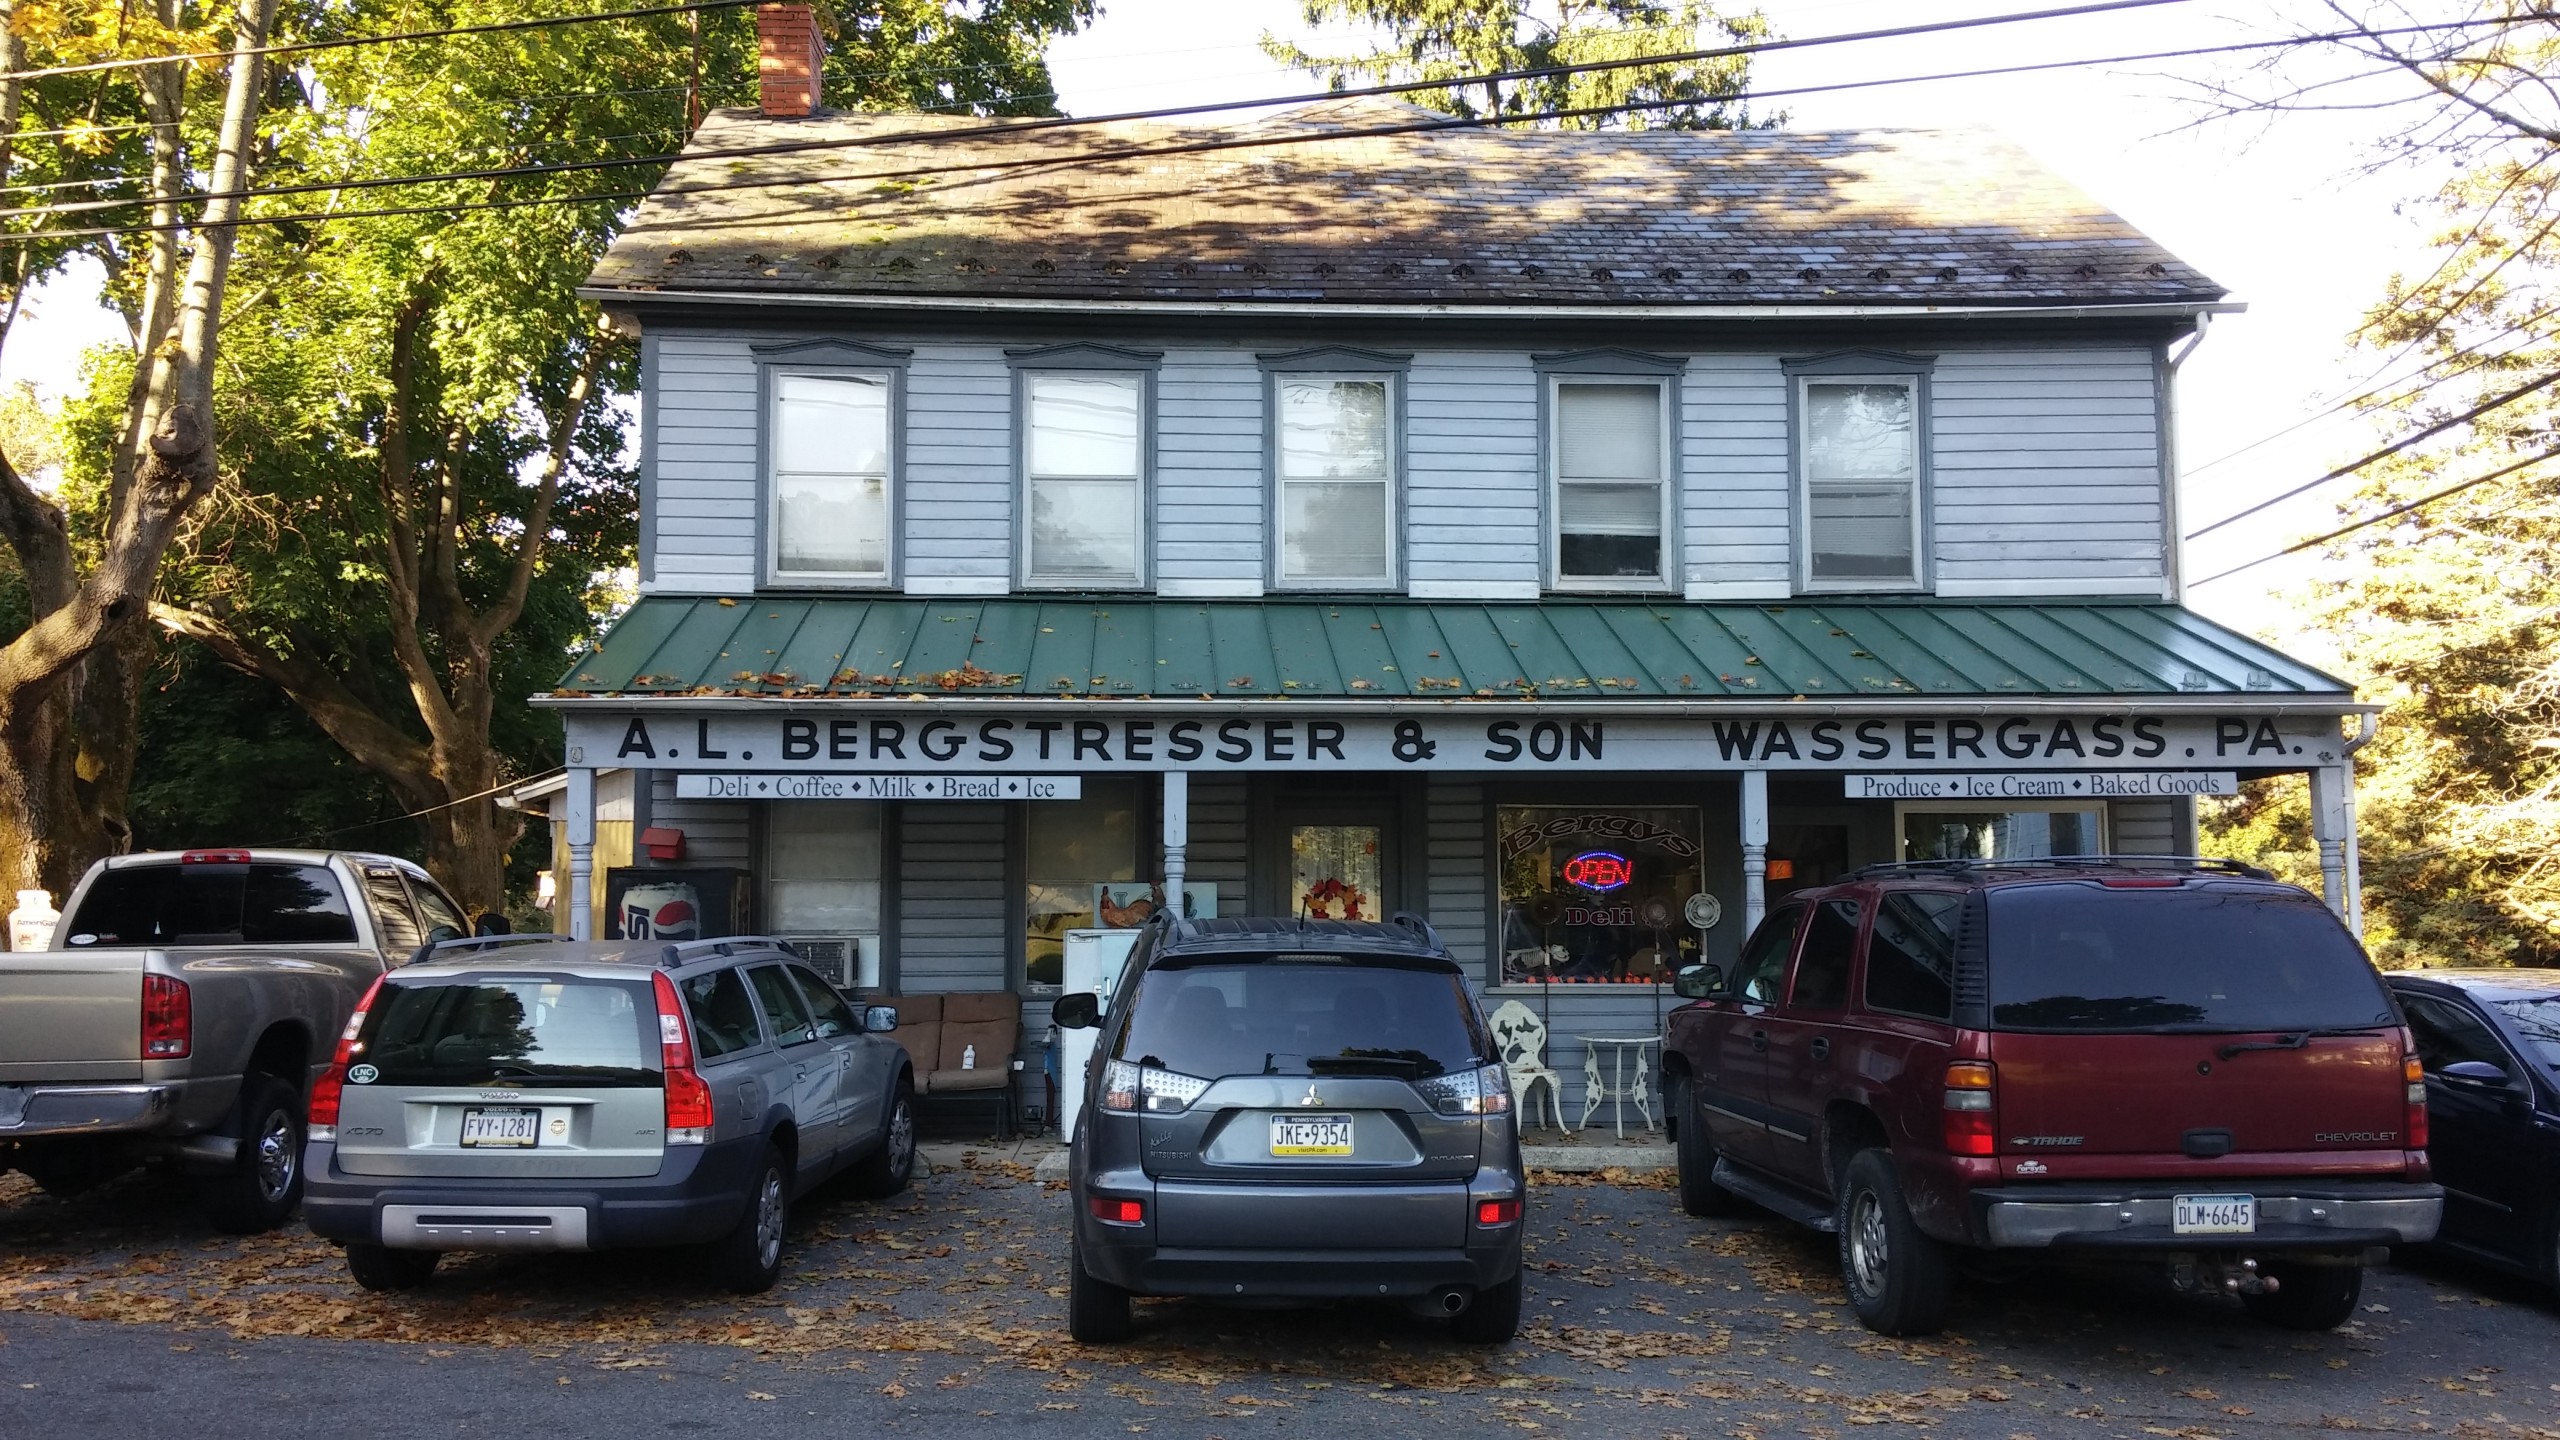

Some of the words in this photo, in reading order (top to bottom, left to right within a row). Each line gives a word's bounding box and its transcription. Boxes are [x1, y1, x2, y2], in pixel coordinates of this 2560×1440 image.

[781, 718, 1346, 762] BERGSTRESSER
[1391, 718, 1436, 761] &
[1484, 719, 1603, 763] SON
[707, 775, 750, 797] Deli
[775, 775, 844, 798] Coffee
[868, 775, 917, 798] Milk
[941, 775, 1000, 798] Bread
[1025, 776, 1056, 798] Ice
[1861, 774, 1942, 798] Produce
[1965, 773, 1996, 797] Ice
[2000, 773, 2066, 797] Cream
[2089, 772, 2152, 796] Baked
[2158, 771, 2221, 796] Goods
[1564, 859, 1633, 885] OPEN
[1565, 907, 1636, 926] Deli
[354, 1068, 374, 1076] LNC
[480, 1091, 520, 1099] VOLVO
[2032, 1135, 2085, 1146] TAHOE
[2314, 1131, 2398, 1143] CHEVROLET
[1149, 1150, 1192, 1159] MITSUBISHI
[2016, 1164, 2048, 1174] Forsyth
